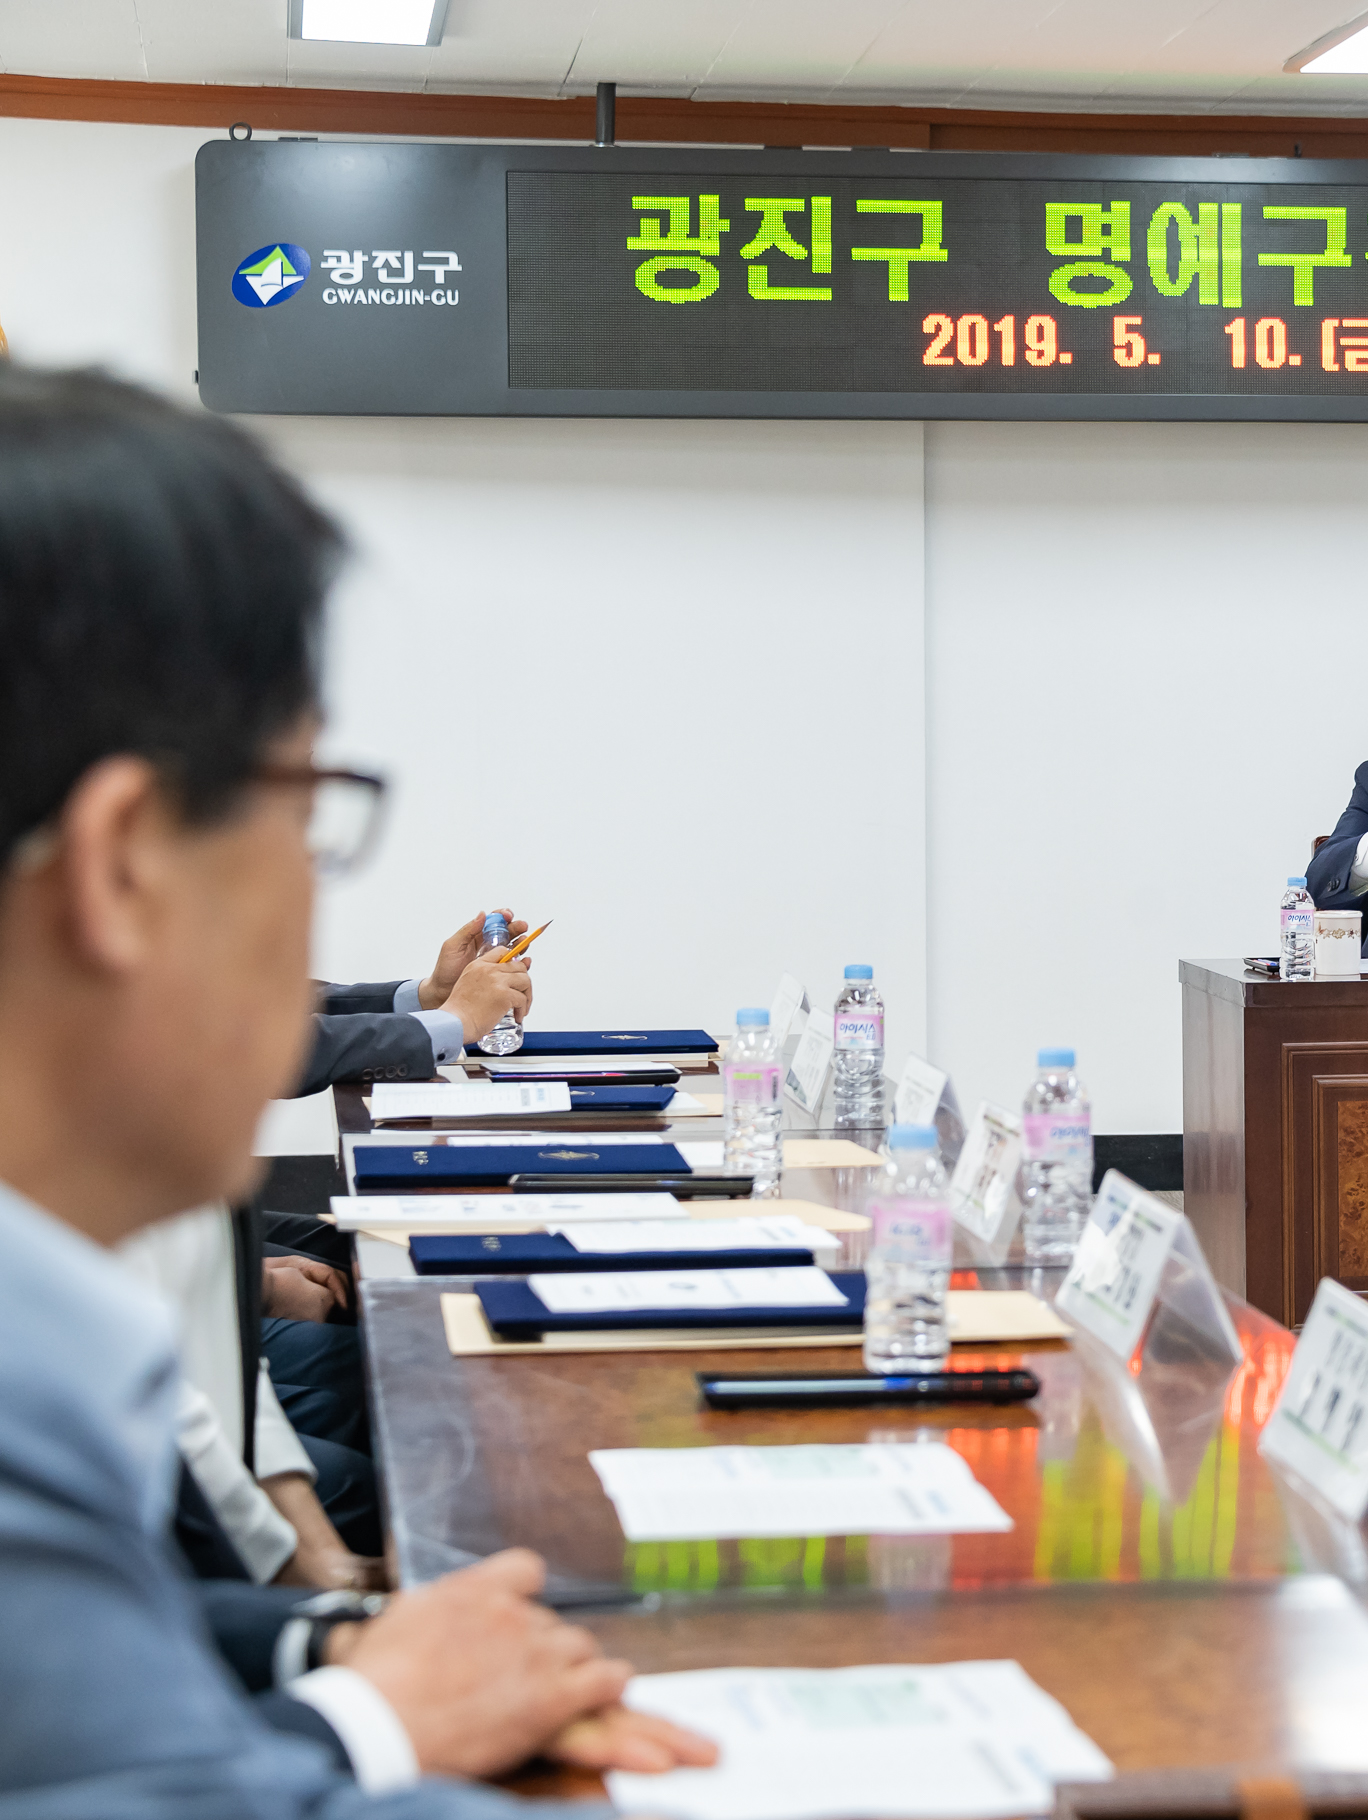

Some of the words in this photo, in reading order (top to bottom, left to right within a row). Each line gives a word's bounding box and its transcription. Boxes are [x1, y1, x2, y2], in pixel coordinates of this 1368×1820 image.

[320, 249, 463, 286] 광진구
[626, 194, 949, 305] 광진구
[322, 287, 460, 307] GWANGJIN-GU
[921, 312, 1074, 367] 2019.
[1112, 314, 1162, 368] 5.
